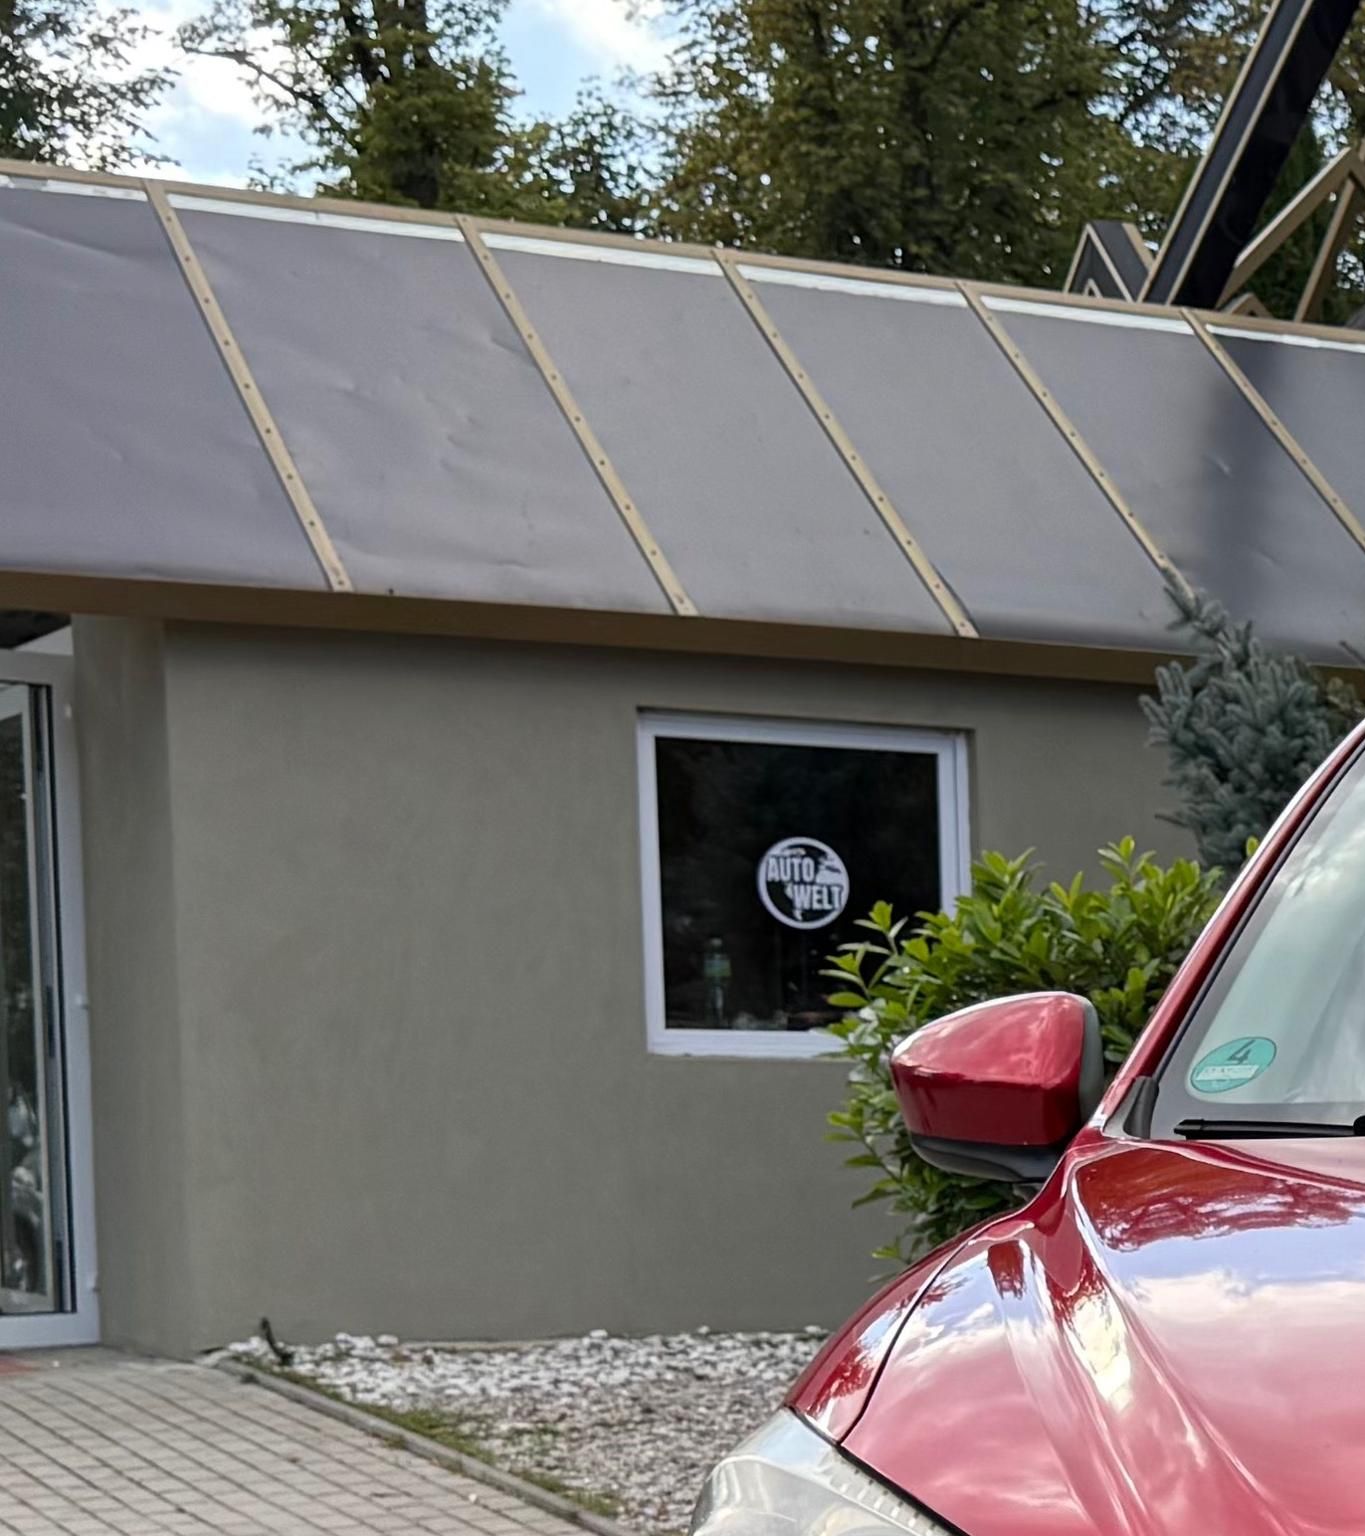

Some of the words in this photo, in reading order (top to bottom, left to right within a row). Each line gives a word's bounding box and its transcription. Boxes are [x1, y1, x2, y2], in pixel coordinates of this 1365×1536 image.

[766, 858, 815, 881] AUTO
[795, 885, 842, 910] WELT
[1226, 1039, 1256, 1066] 4
